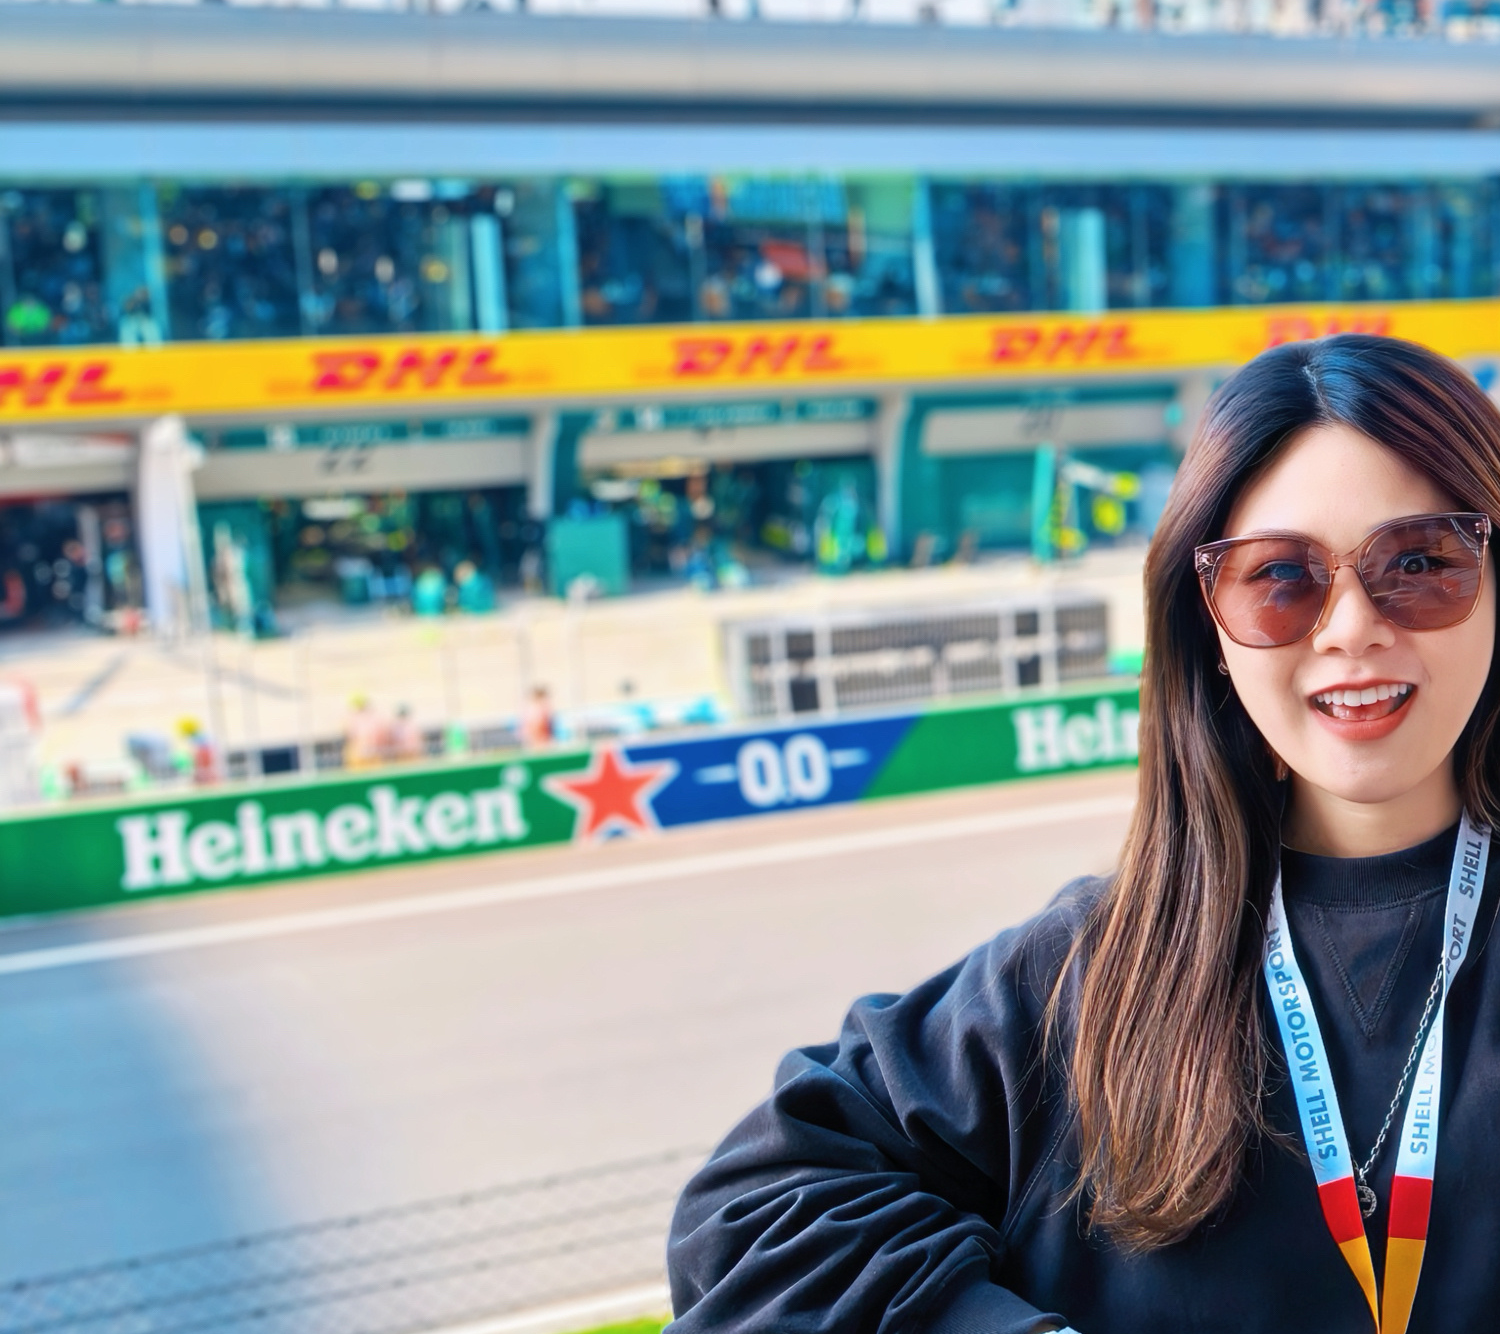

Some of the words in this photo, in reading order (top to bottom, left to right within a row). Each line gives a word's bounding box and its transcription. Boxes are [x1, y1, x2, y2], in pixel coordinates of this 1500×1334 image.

[310, 346, 510, 393] DHL
[668, 334, 848, 379] DHL
[991, 324, 1136, 364] DHL
[0, 361, 126, 409] HL
[737, 733, 832, 809] 0.0
[118, 783, 527, 889] Heineken
[1458, 839, 1484, 900] SHELL
[1306, 1088, 1338, 1161] SHELL
[1409, 1083, 1433, 1155] SHELL
